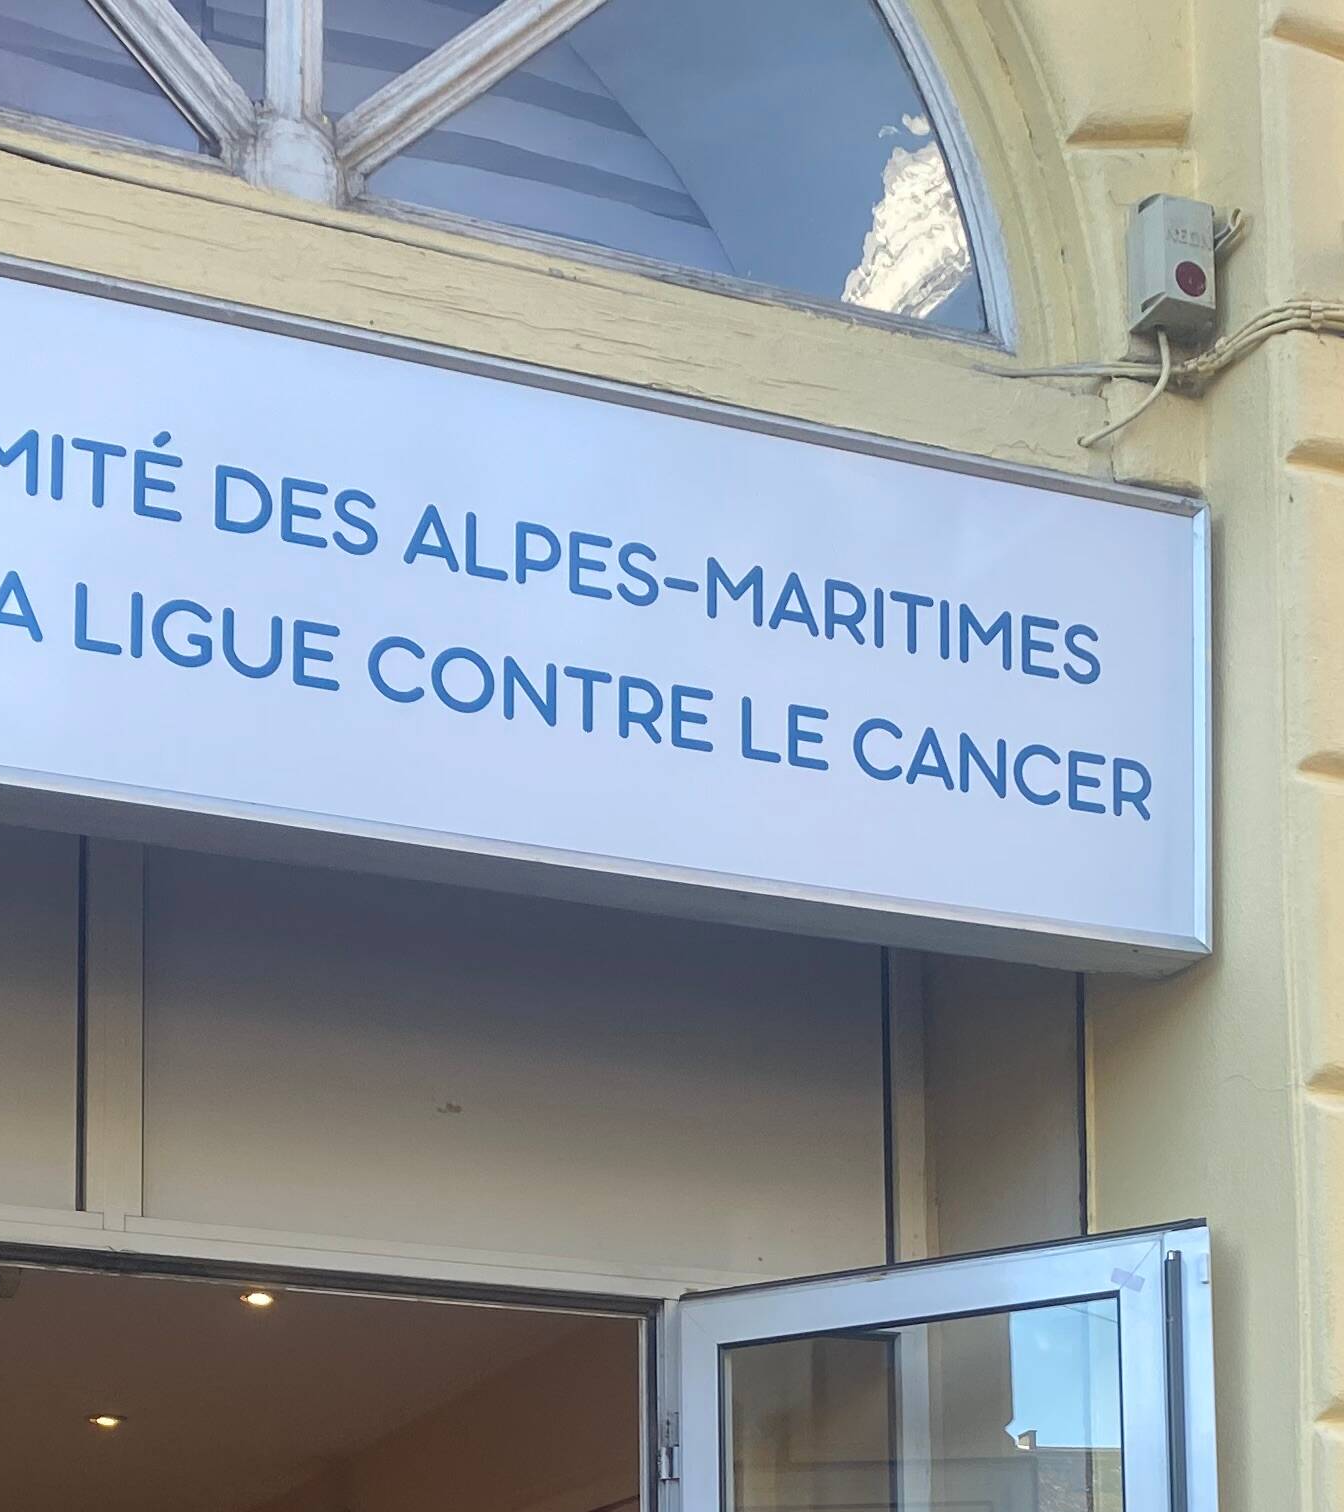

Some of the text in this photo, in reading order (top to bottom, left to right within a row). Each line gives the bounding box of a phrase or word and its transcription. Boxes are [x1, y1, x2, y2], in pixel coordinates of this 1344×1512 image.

[215, 464, 379, 556] DES
[404, 504, 1102, 686] ALPES-MARITIMES
[74, 581, 341, 692] LIGUE
[367, 635, 714, 755] CONTRE
[741, 695, 830, 772] LE
[853, 717, 1153, 822] CANCER
